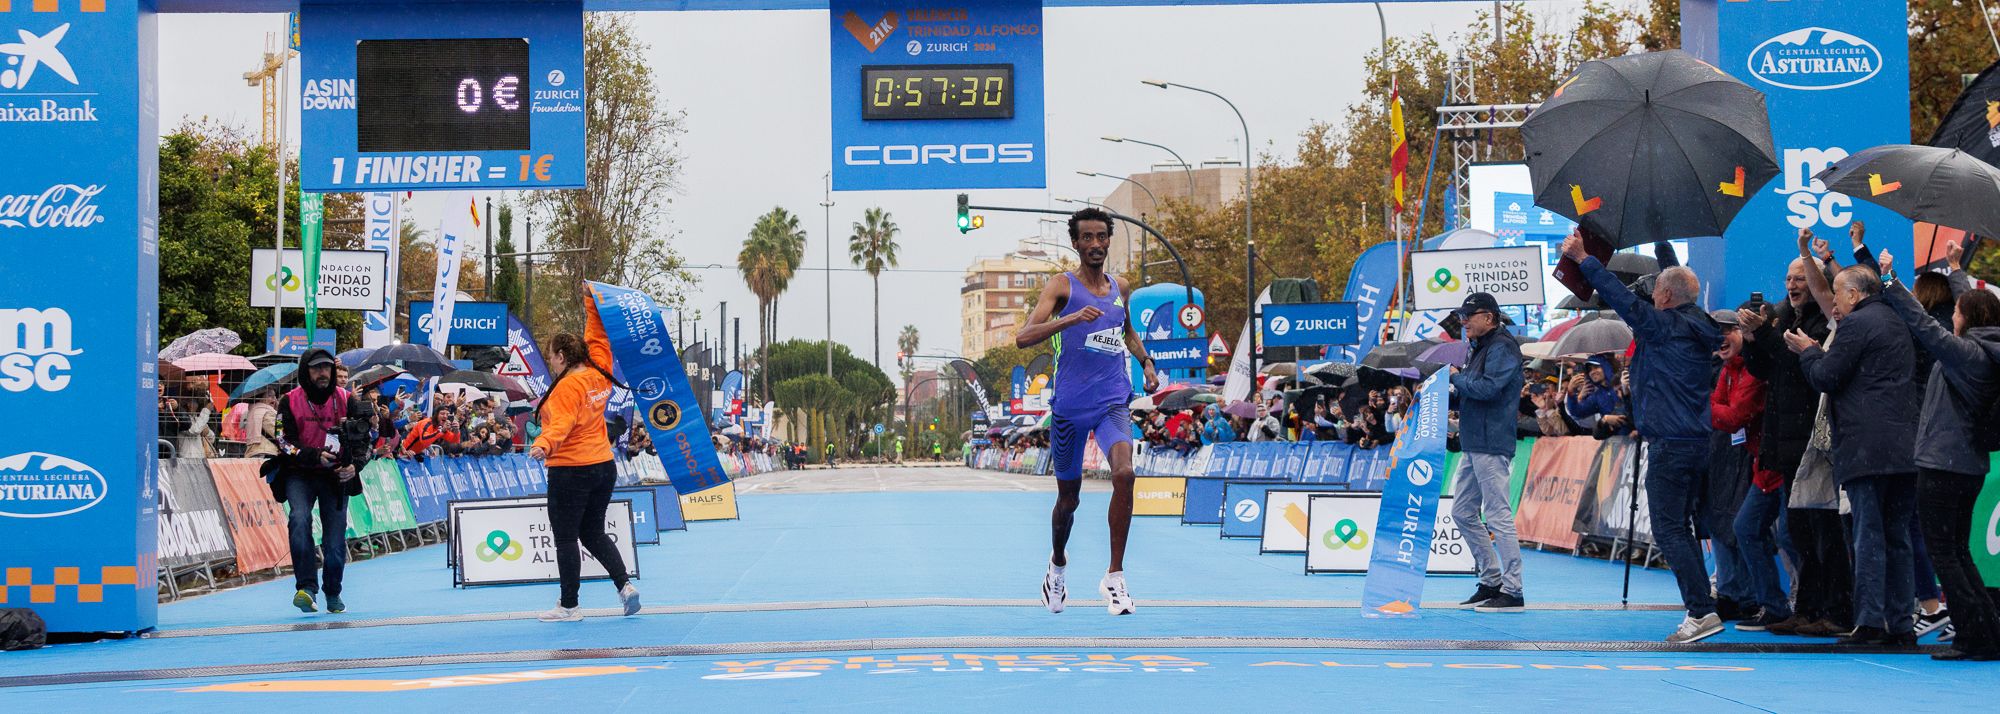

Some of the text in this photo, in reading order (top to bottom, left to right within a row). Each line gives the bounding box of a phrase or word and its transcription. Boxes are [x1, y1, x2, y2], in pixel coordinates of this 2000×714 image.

[869, 17, 894, 46] 21K
[908, 24, 1039, 37] TRINIDAD ALFONSO
[927, 43, 968, 52] ZURICH
[1758, 51, 1873, 74] ASTURIANA
[303, 79, 355, 97] ASIN
[457, 76, 519, 112] 0 €
[534, 89, 579, 100] ZURICH
[873, 77, 1003, 107] 0:57:30
[303, 97, 356, 110] DOWN
[531, 102, 583, 114] Foundation
[844, 143, 1034, 166] COROS
[332, 157, 345, 184] 1
[355, 156, 482, 184] FINISHER
[519, 154, 554, 182] 1€
[321, 264, 371, 272] NDACIÓN
[1464, 260, 1528, 270] FUNDACIÓN
[317, 274, 371, 285] RINIDAD
[1464, 270, 1528, 283] TRINIDAD
[318, 286, 371, 297] FONSO
[624, 292, 649, 340] TRINIDAD
[632, 291, 660, 335] ALFONSO
[450, 318, 497, 330] URICH
[1295, 318, 1347, 331] ZURICH
[0, 483, 96, 501] STURIANA
[1397, 492, 1422, 564] ZURICH
[711, 653, 1190, 667] VALENCIA
[1247, 661, 1755, 672] ALFONSO
